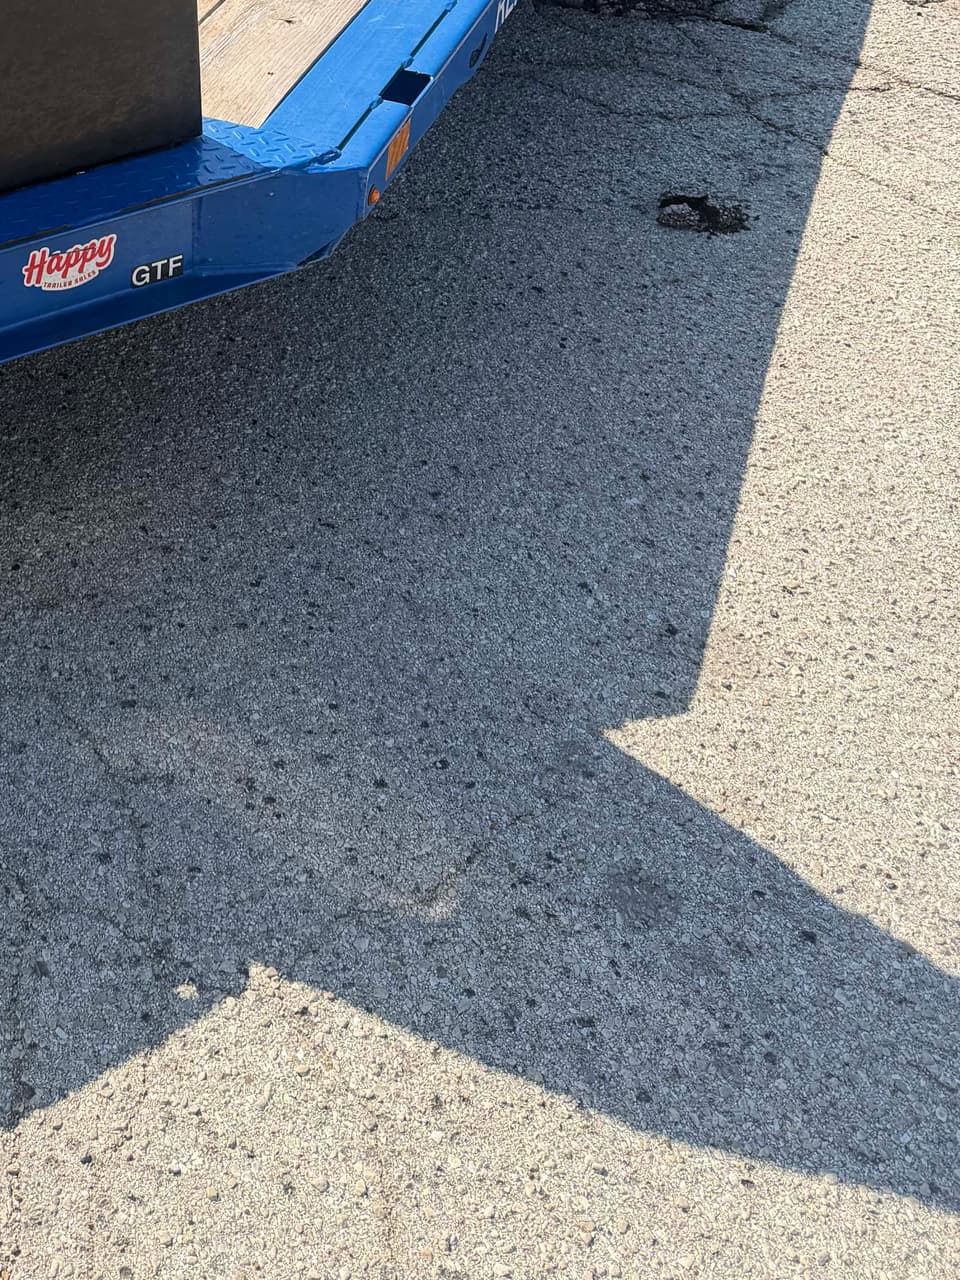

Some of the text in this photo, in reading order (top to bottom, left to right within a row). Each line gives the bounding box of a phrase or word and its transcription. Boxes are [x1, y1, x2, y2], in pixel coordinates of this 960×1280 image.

[24, 236, 115, 285] Happy
[132, 254, 183, 286] GTF
[43, 271, 96, 289] TRAILER SALES
